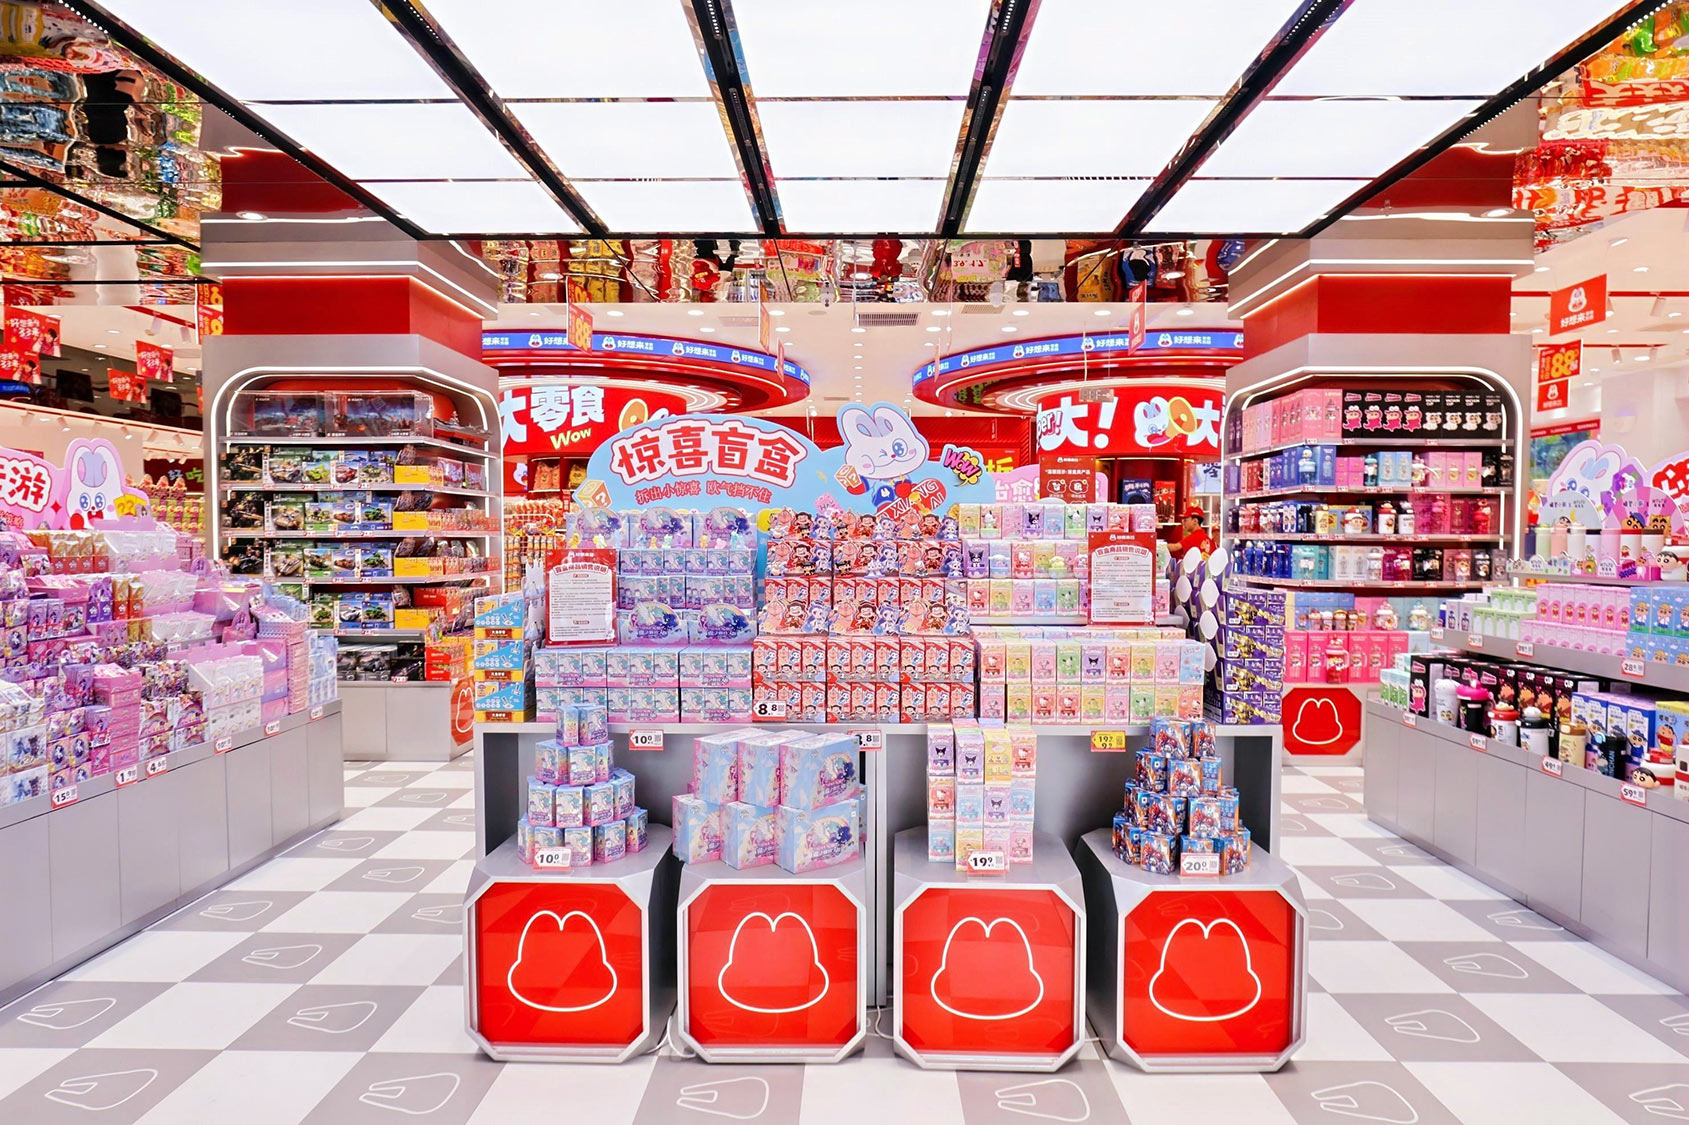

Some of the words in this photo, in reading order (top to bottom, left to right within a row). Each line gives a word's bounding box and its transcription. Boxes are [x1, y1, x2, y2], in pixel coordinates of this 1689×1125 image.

[551, 428, 592, 449] Wow
[618, 425, 801, 482] 惊喜盲盒
[0, 464, 46, 505] 游
[635, 480, 702, 505] 拆出小惊喜
[705, 480, 773, 505] 欧气挡不住
